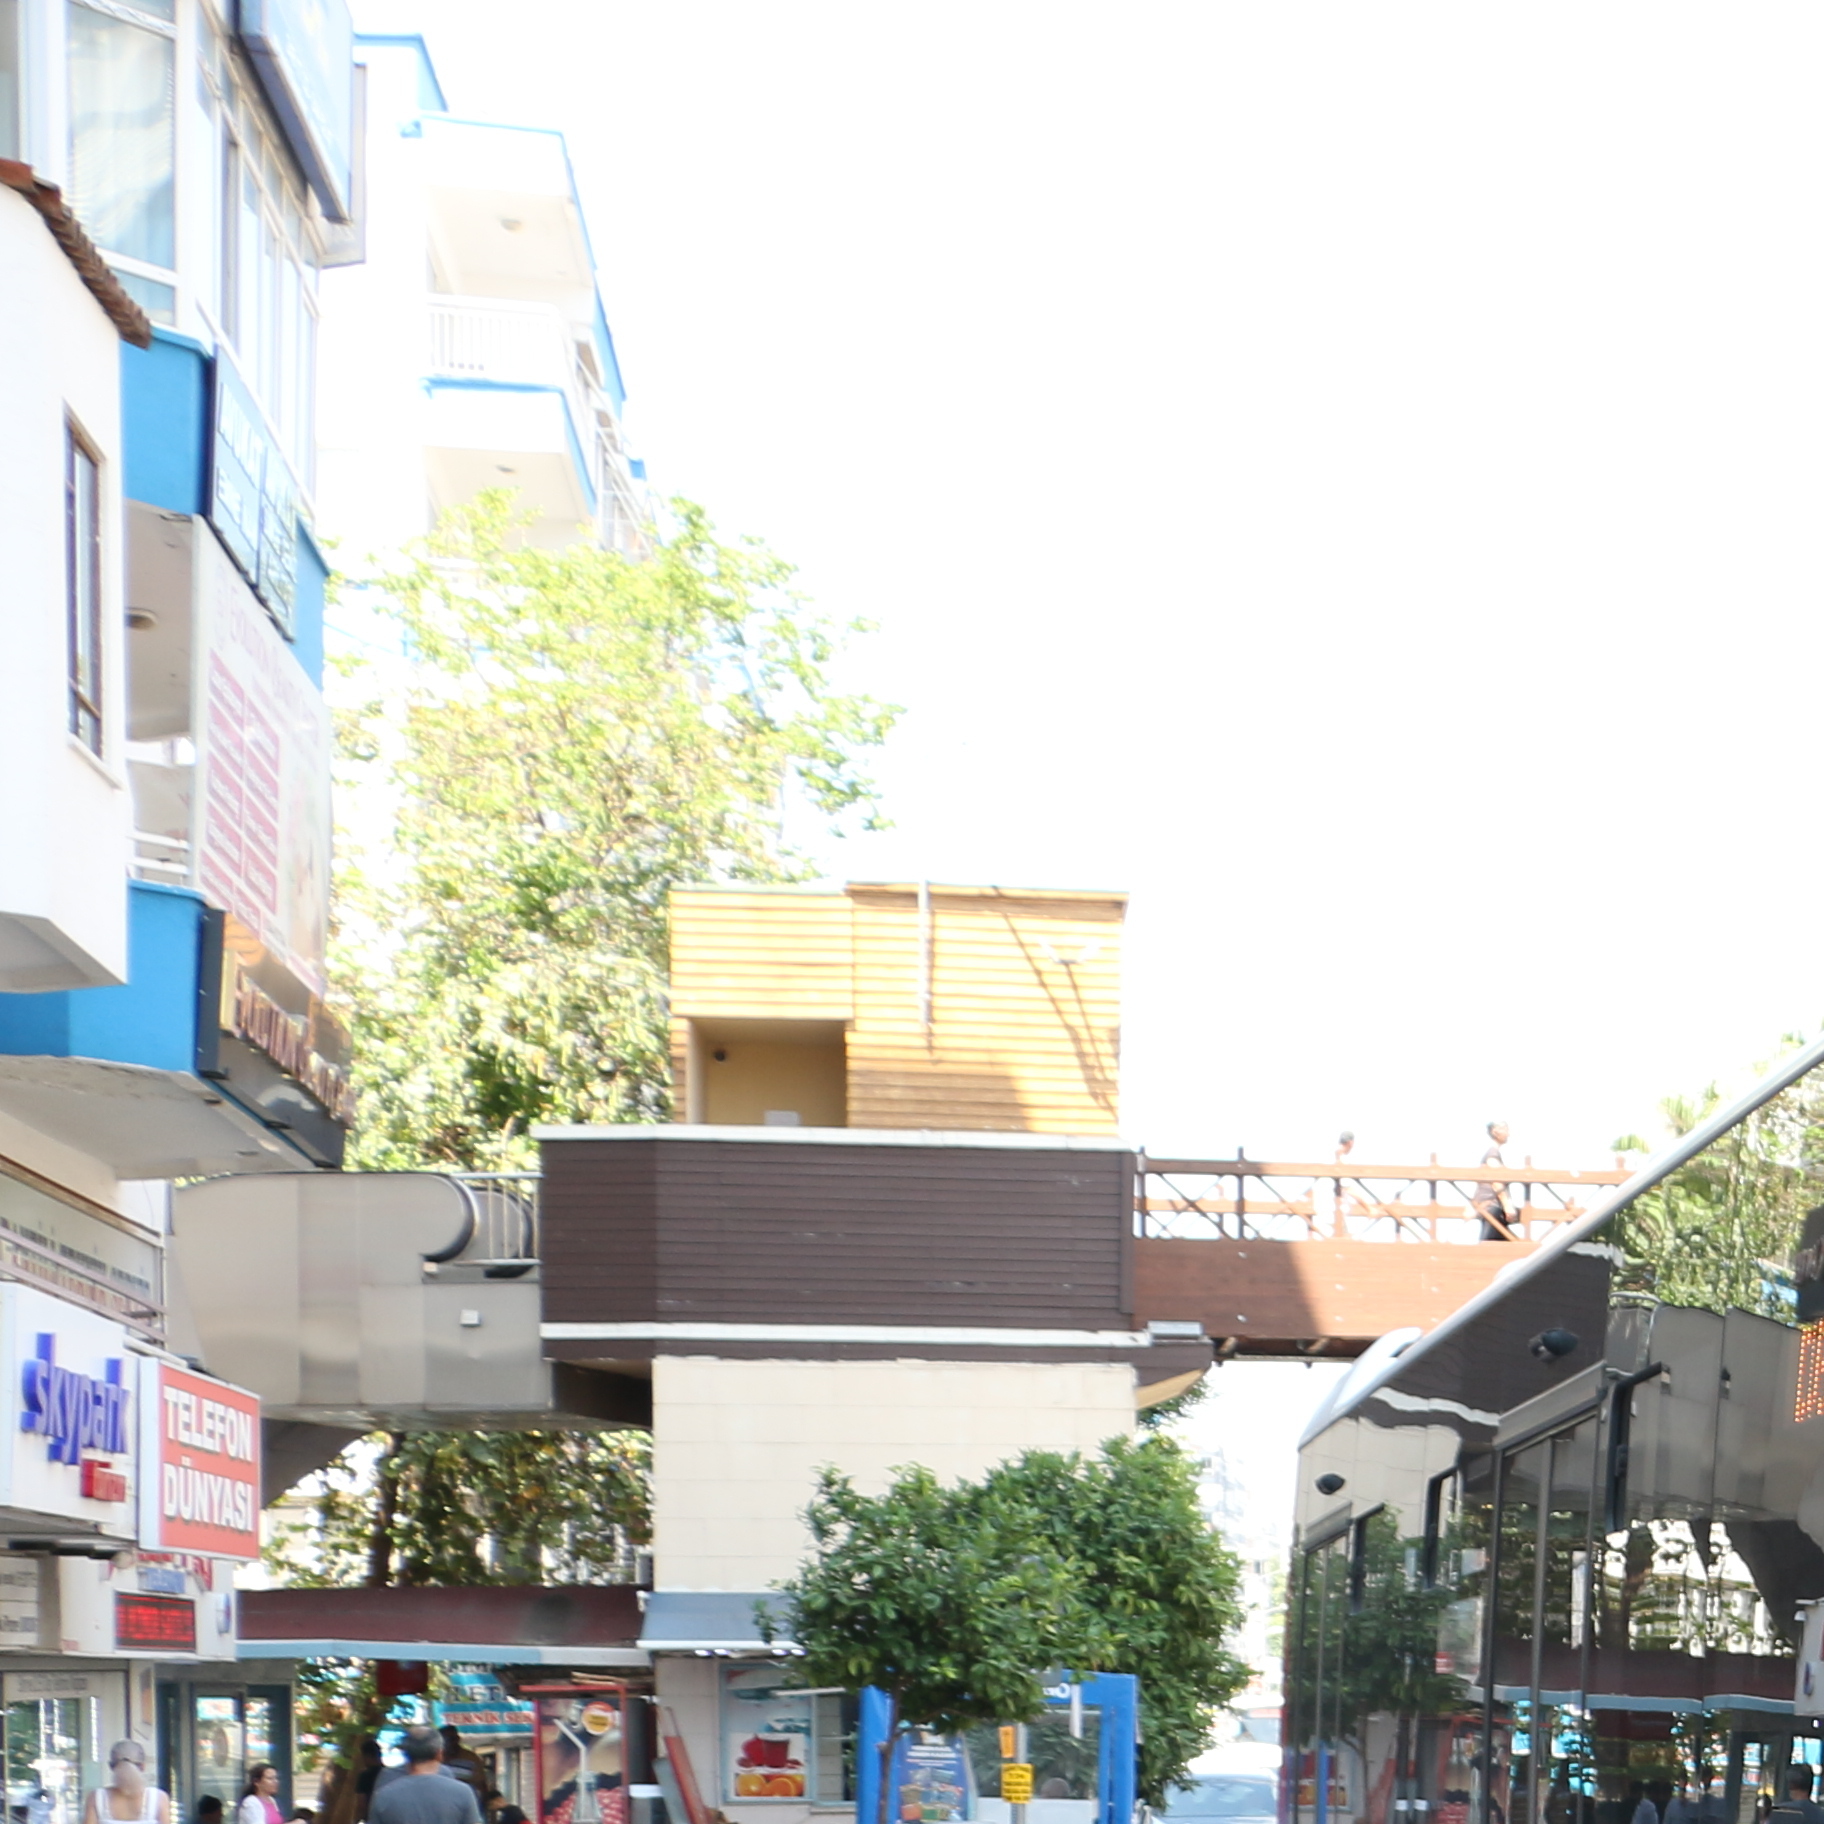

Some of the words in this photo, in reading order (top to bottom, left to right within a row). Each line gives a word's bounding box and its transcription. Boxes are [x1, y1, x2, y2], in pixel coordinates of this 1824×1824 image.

[21, 1332, 130, 1465] skypark
[163, 1385, 253, 1462] TELEFON
[163, 1456, 254, 1532] DÜNYASI
